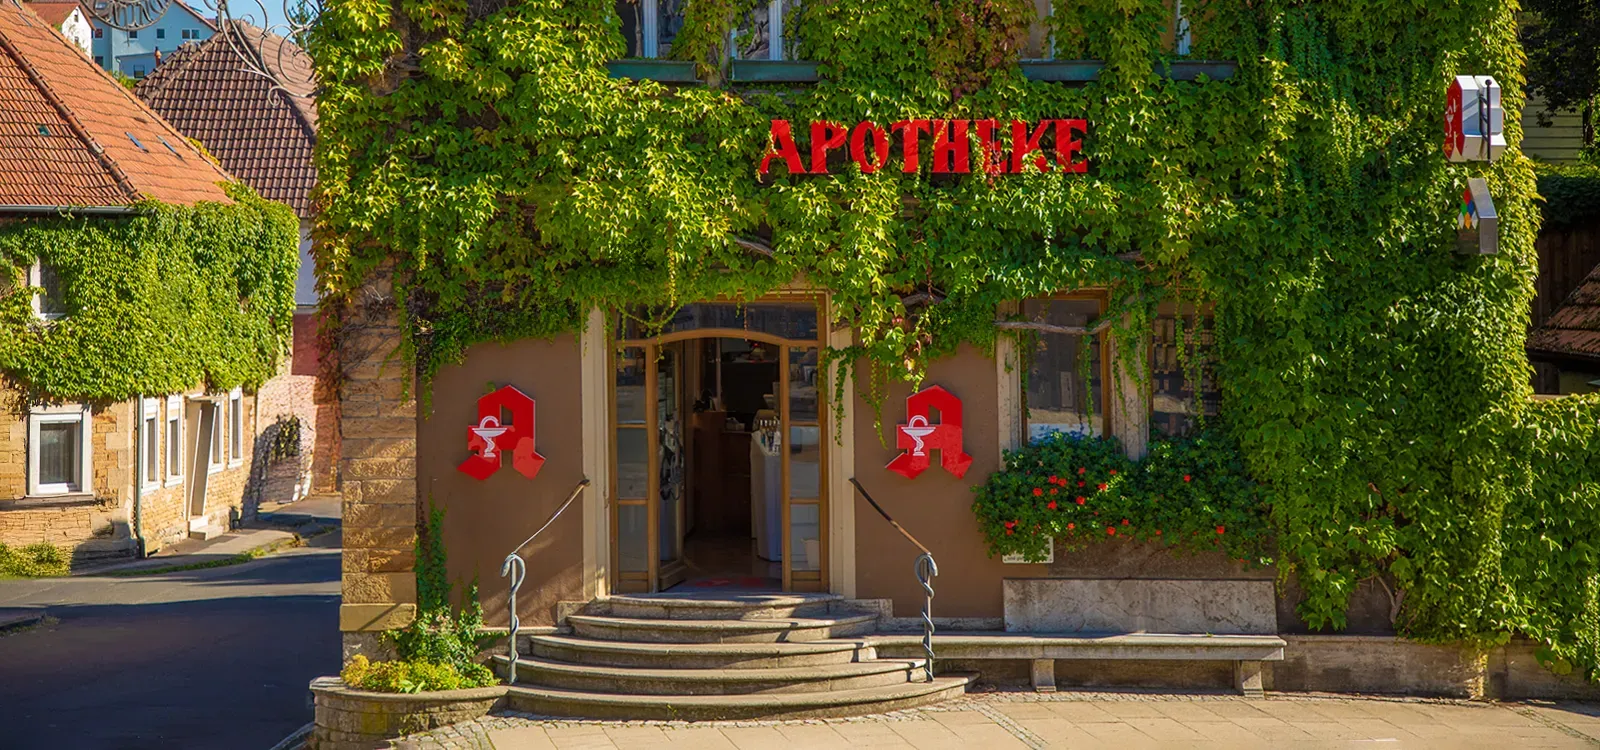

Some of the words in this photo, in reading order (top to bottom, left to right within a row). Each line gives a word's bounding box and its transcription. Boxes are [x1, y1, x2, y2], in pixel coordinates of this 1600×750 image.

[759, 119, 1088, 173] APOTHEKE
[456, 384, 546, 480] A
[885, 384, 973, 480] A
